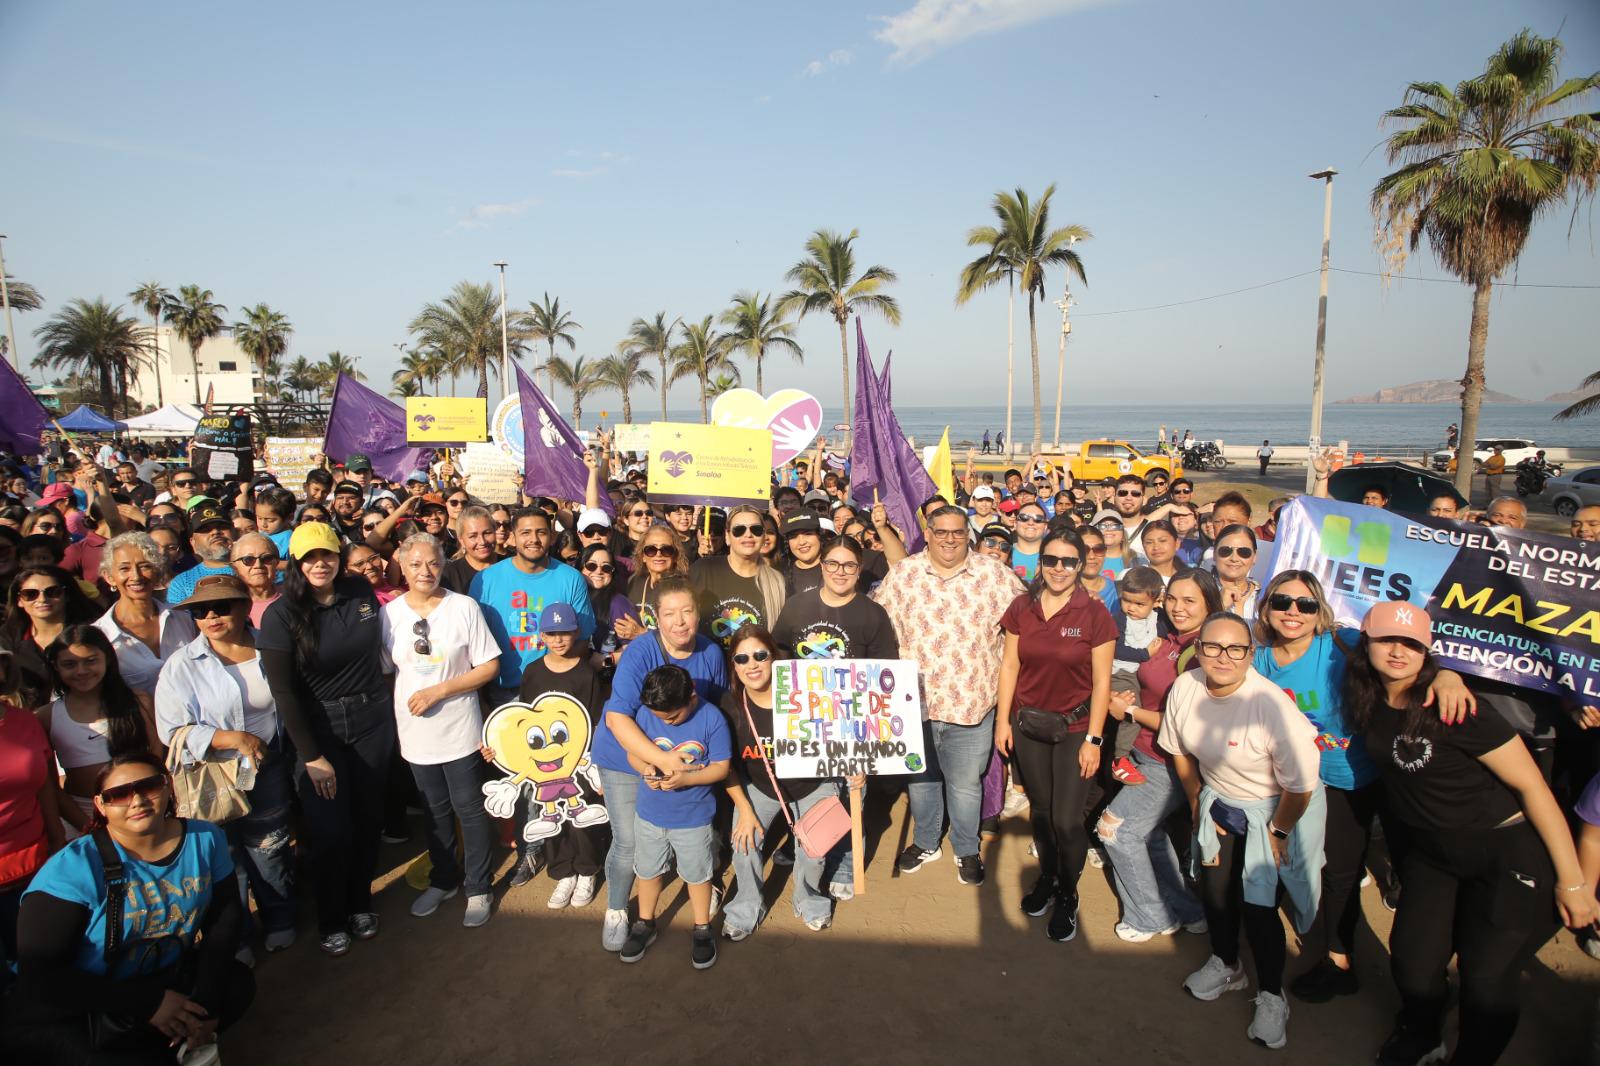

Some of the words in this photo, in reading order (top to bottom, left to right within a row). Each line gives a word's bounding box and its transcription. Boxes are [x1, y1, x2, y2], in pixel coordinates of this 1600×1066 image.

[695, 470, 722, 479] Sinaloa
[1405, 524, 1511, 556] ESCUELA
[1519, 543, 1600, 571] NORM
[1487, 556, 1536, 580] DEL
[511, 590, 545, 612] au
[1440, 582, 1600, 645] MAZA
[1395, 607, 1414, 626] NY
[1430, 620, 1553, 661] LICENCIATURA
[1557, 651, 1585, 669] EN
[1431, 639, 1553, 680] ATENCIÓN
[1557, 672, 1576, 692] A
[1583, 677, 1600, 698] L
[775, 689, 803, 714] ES
[808, 691, 863, 720] PARTE
[869, 691, 892, 717] DE
[787, 715, 833, 744] ESTE
[840, 715, 904, 743] MUNDO
[776, 739, 798, 757] NO
[801, 741, 820, 757] ES
[826, 740, 848, 759] UN
[853, 740, 907, 759] MUNDO
[816, 757, 878, 777] APARTE
